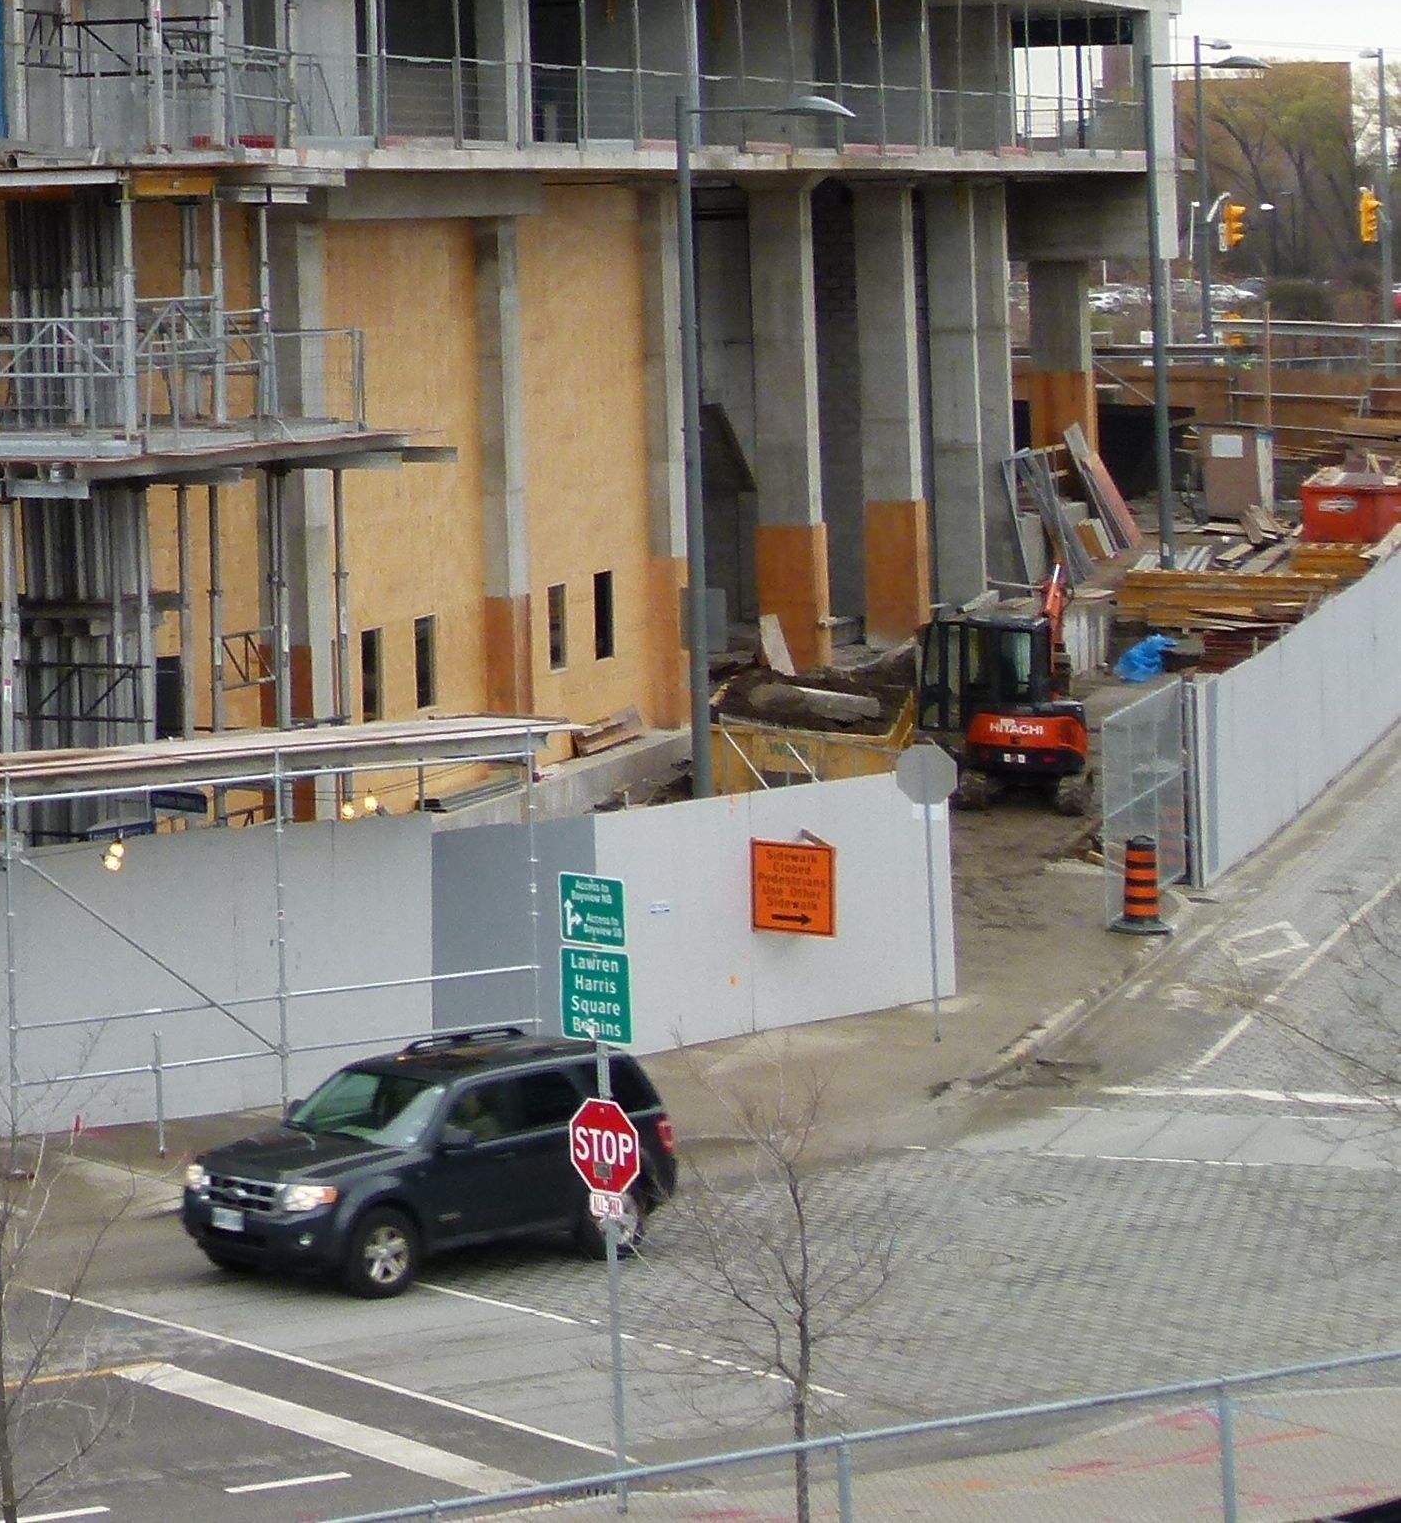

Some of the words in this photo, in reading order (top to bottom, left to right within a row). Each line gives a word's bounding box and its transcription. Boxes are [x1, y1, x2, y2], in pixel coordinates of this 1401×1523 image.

[990, 721, 1044, 735] HITACHI
[766, 849, 818, 864] Sidewalk
[773, 861, 811, 875] Closed
[575, 880, 600, 892] Access
[601, 884, 609, 893] to
[758, 872, 826, 888] Pedestrians
[571, 889, 600, 903] Bayview
[762, 885, 783, 895] Use
[790, 887, 820, 899] Other
[766, 897, 817, 910] Sidewalk
[586, 913, 610, 925] Access
[610, 917, 619, 926] to
[583, 923, 612, 936] Bayview
[571, 953, 619, 973] Lawren
[575, 974, 616, 994] Harris
[571, 995, 620, 1016] Square
[575, 1126, 633, 1166] STOP
